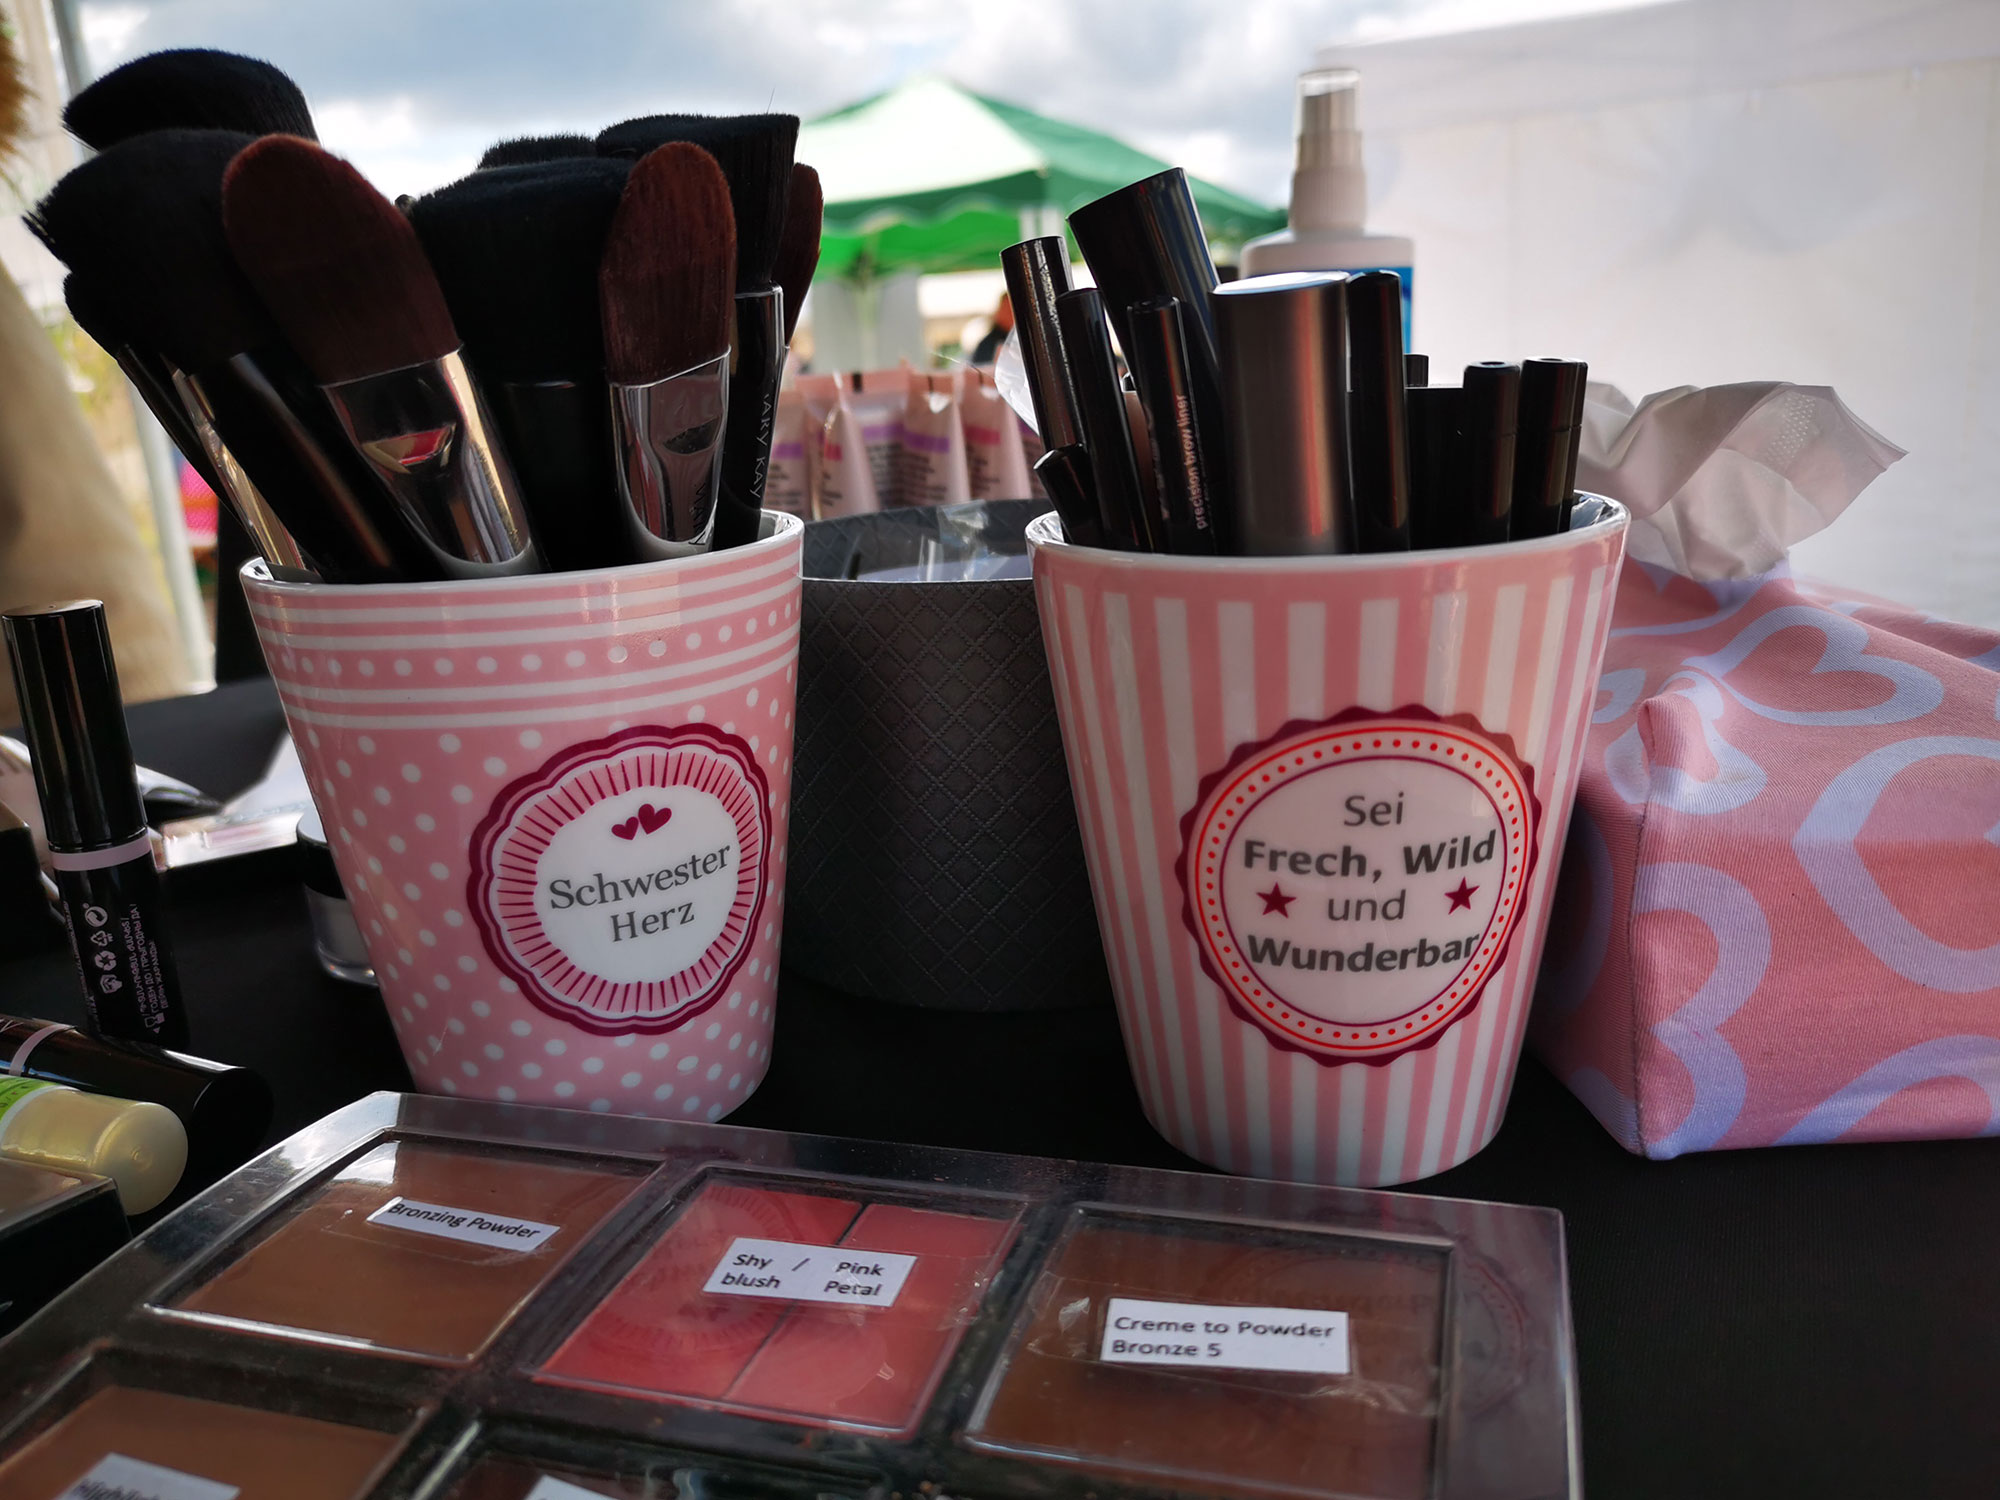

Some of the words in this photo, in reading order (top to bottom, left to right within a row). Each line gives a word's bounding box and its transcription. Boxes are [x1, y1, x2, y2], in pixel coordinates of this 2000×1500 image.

[756, 393, 772, 446] ARY
[1176, 394, 1191, 428] liner
[1182, 429, 1198, 466] brow
[749, 457, 765, 498] KAY
[1187, 466, 1208, 530] precision
[1343, 791, 1405, 826] Sei
[1243, 839, 1383, 883] Frech,
[1402, 829, 1496, 875] Wild
[549, 845, 731, 909] Schwester
[610, 902, 695, 942] Herz
[1327, 889, 1407, 921] und
[1247, 934, 1480, 972] Wunderbar
[387, 1203, 467, 1228] Bronzing
[467, 1217, 541, 1239] Powder
[732, 1254, 774, 1270] Shy
[835, 1261, 885, 1276] Pink
[721, 1272, 781, 1289] blush
[823, 1281, 882, 1296] Petal
[1114, 1316, 1195, 1333] Creme
[1204, 1321, 1230, 1334] to
[1238, 1321, 1336, 1337] Powder
[1112, 1340, 1198, 1356] Bronze
[1207, 1343, 1223, 1357] 5
